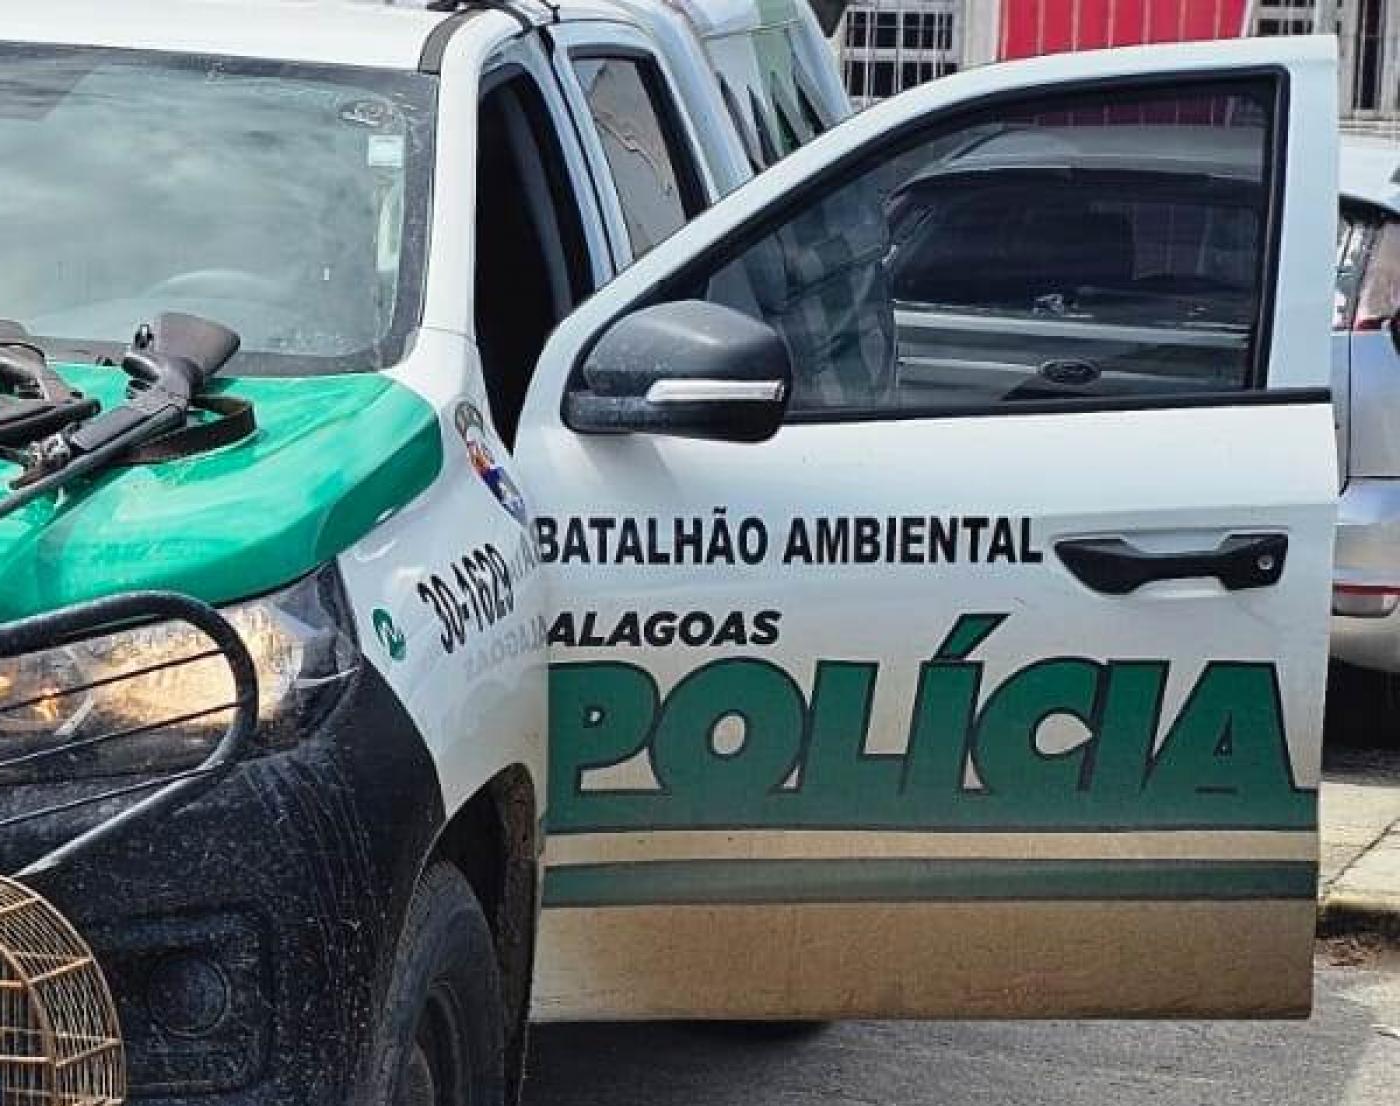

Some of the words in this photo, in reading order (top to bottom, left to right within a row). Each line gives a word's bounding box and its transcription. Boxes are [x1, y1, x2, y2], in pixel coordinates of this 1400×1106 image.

[534, 506, 769, 565] BATALHÃO
[783, 516, 1043, 565] AMBIENTAL
[546, 610, 782, 647] ALAGOAS
[547, 613, 1316, 832] POLÍCIA
